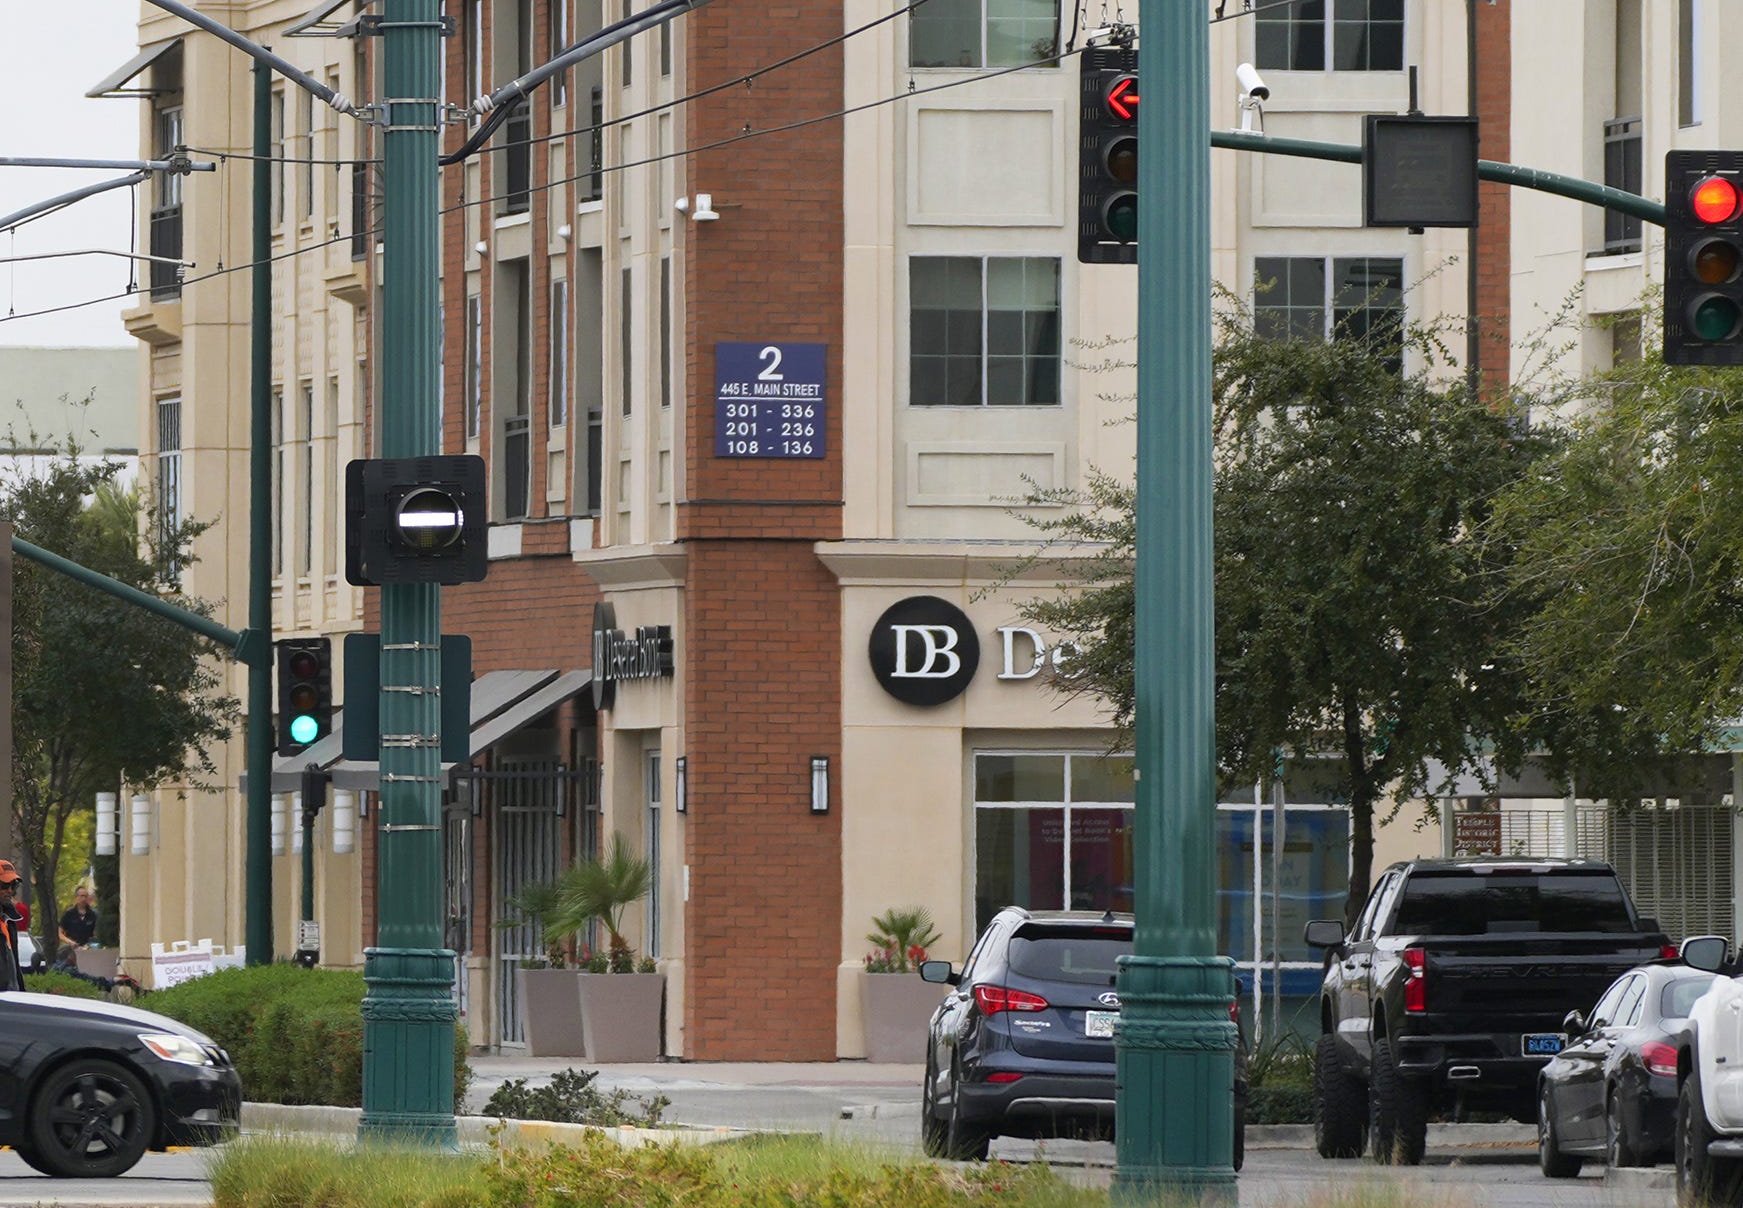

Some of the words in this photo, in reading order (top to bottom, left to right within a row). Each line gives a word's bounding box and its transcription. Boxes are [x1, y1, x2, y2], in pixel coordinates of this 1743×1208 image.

[758, 346, 784, 380] 2
[720, 383, 740, 394] 445
[754, 383, 781, 395] MAIN
[783, 383, 820, 396] STREET
[726, 403, 757, 417] 301
[781, 404, 814, 418] 336
[726, 422, 757, 436] 201
[781, 422, 814, 437] 236
[727, 440, 759, 454] 108
[782, 440, 813, 454] 136
[890, 624, 961, 678] DB
